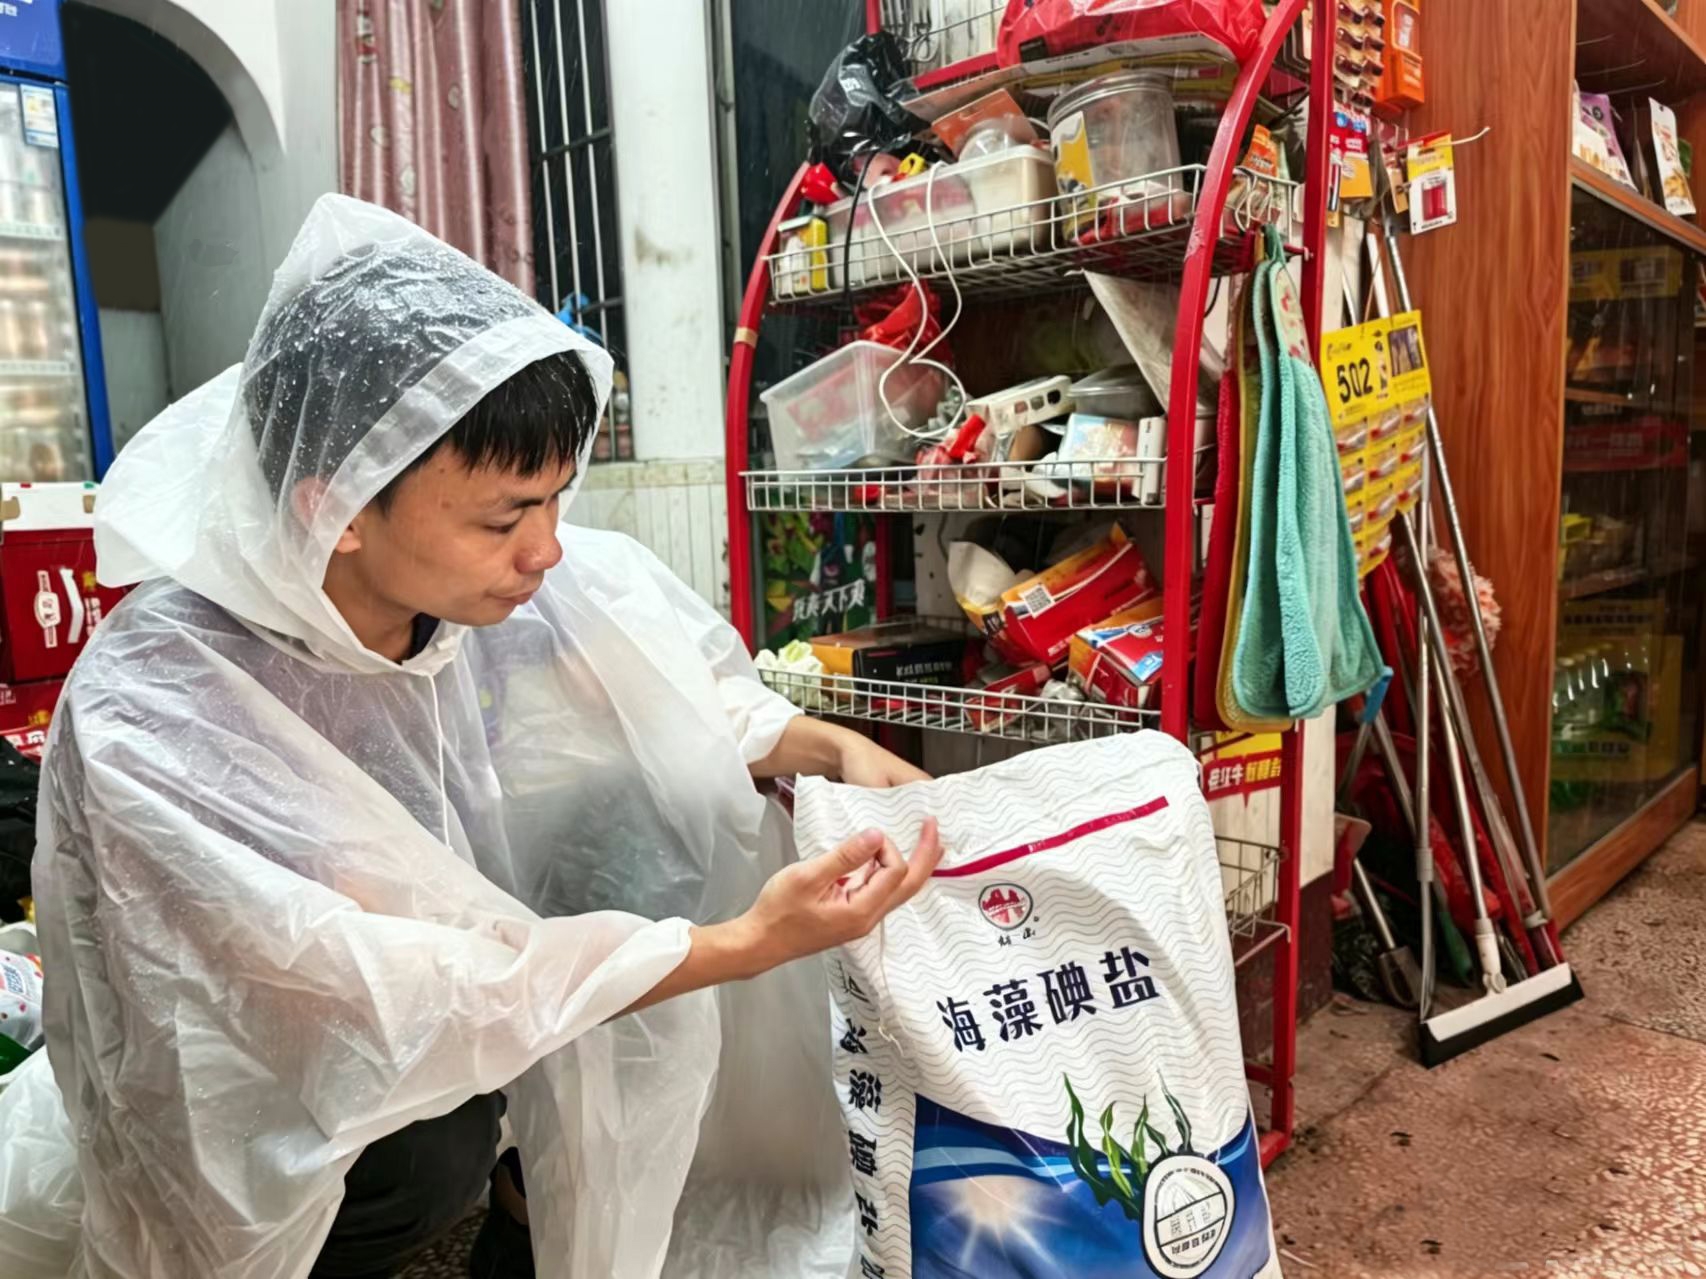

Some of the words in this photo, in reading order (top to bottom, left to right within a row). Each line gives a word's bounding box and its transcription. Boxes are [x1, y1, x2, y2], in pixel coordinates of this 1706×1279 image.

[1336, 356, 1374, 405] 502
[936, 946, 1161, 1053] 海藻碘盐
